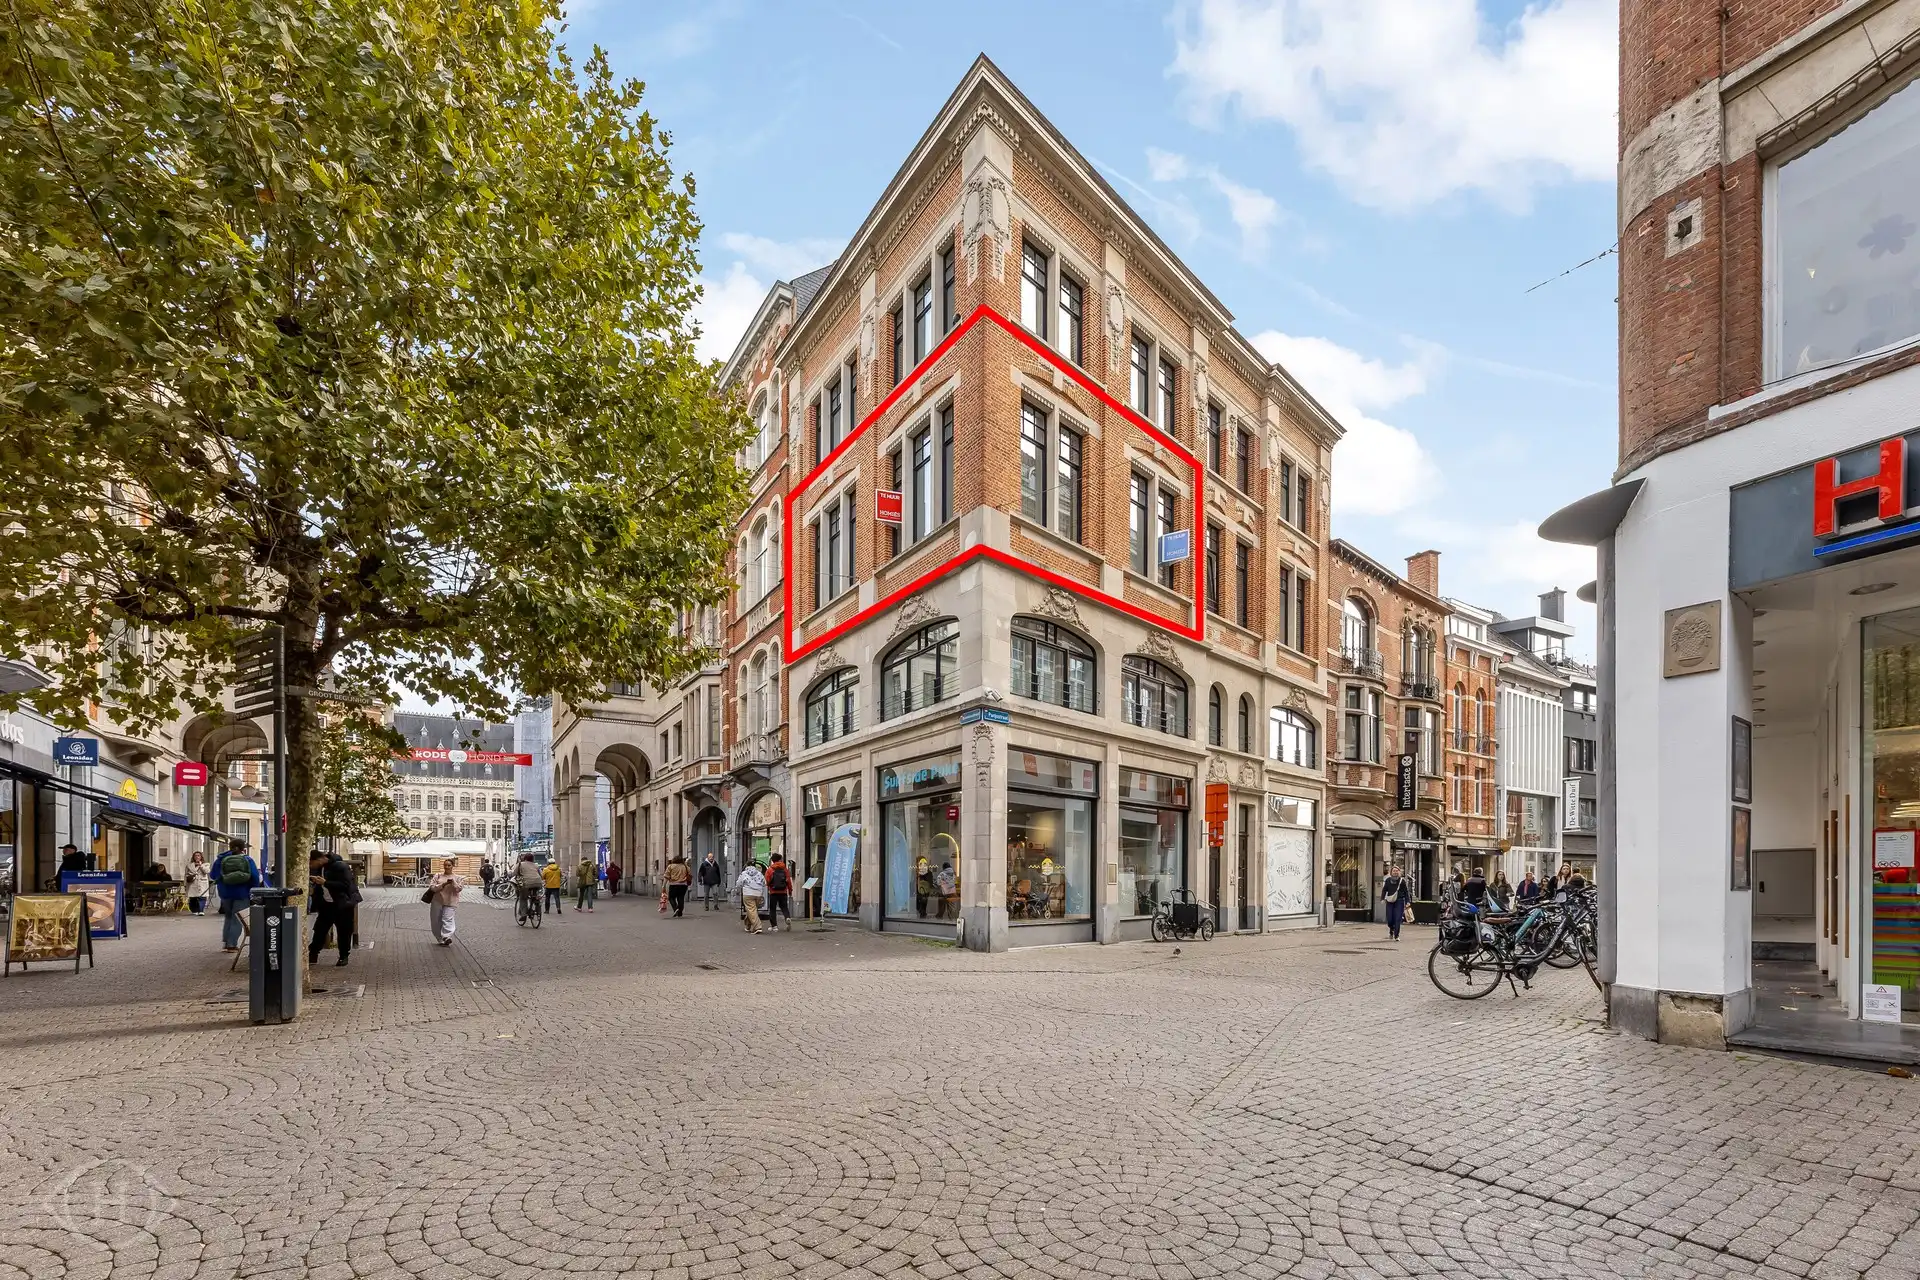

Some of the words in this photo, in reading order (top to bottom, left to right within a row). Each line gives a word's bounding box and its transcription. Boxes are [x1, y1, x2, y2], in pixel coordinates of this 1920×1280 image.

[887, 493, 900, 501] HUUR
[308, 689, 332, 700] GROOT
[468, 753, 501, 762] HOND
[1402, 767, 1411, 808] Intertaste
[1569, 817, 1576, 826] De
[269, 928, 277, 951] leuven
